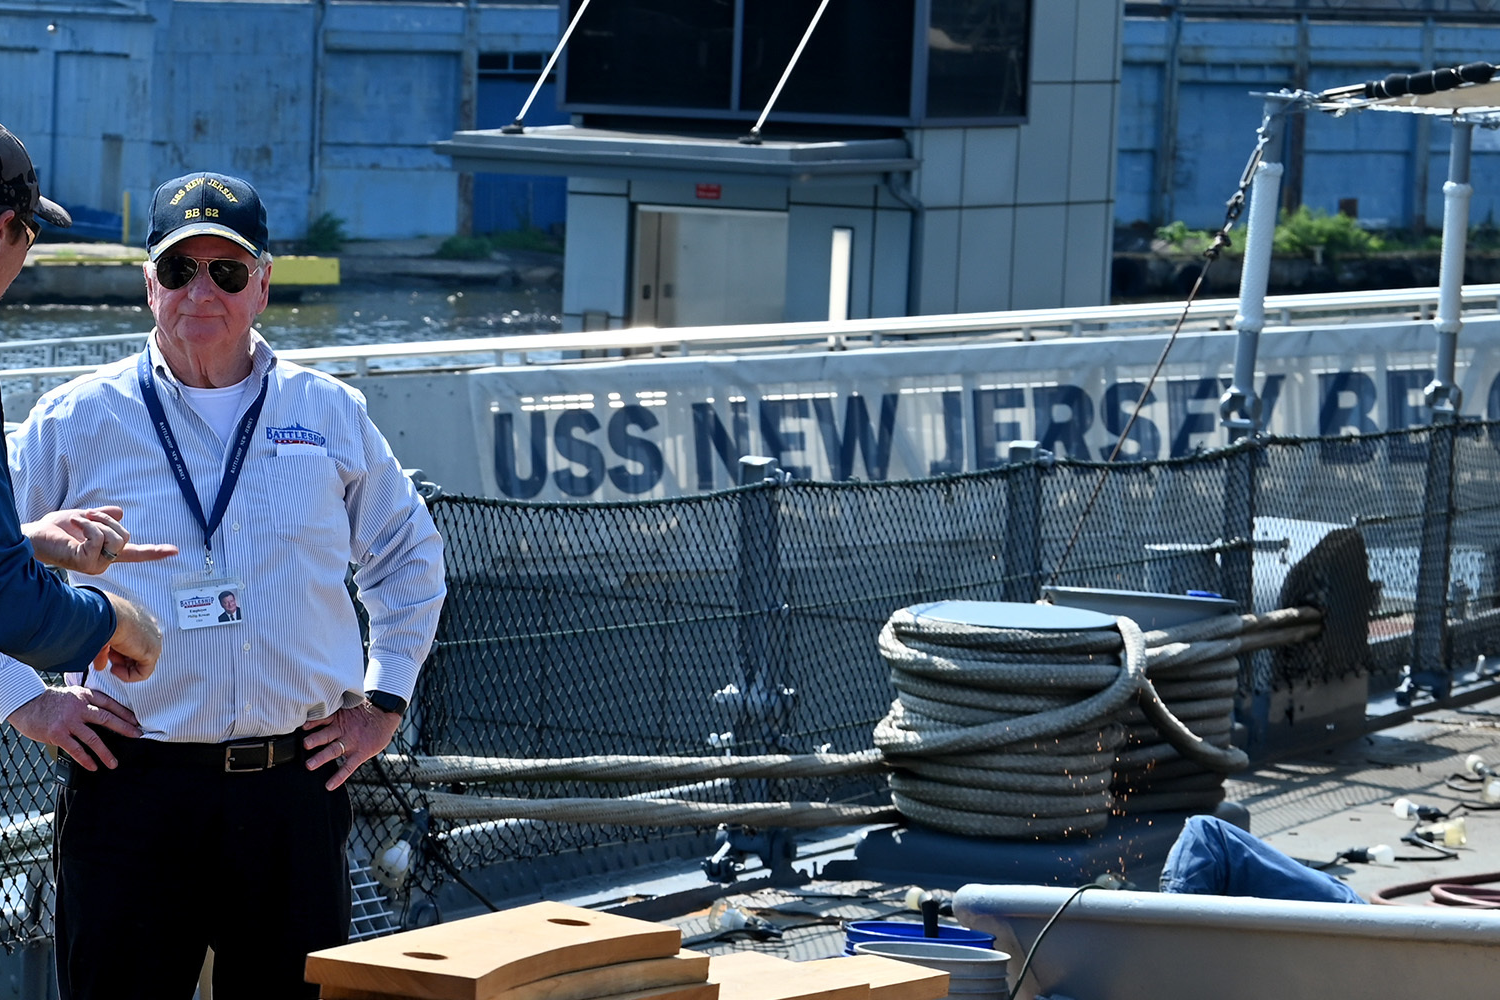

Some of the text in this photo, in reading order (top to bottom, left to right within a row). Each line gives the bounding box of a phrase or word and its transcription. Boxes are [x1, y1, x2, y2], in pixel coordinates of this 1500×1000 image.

[169, 177, 238, 206] USS NEW JERSEY
[184, 207, 219, 219] BB 62
[159, 421, 187, 481] BATTLESHIP NEW JERSEY
[266, 427, 326, 447] BATTLESHIP
[493, 404, 665, 498] USS
[692, 392, 899, 490] NEW
[230, 447, 243, 474] BATTLESHIP
[240, 434, 248, 447] NEW
[180, 597, 214, 608] BATTLESHIP
